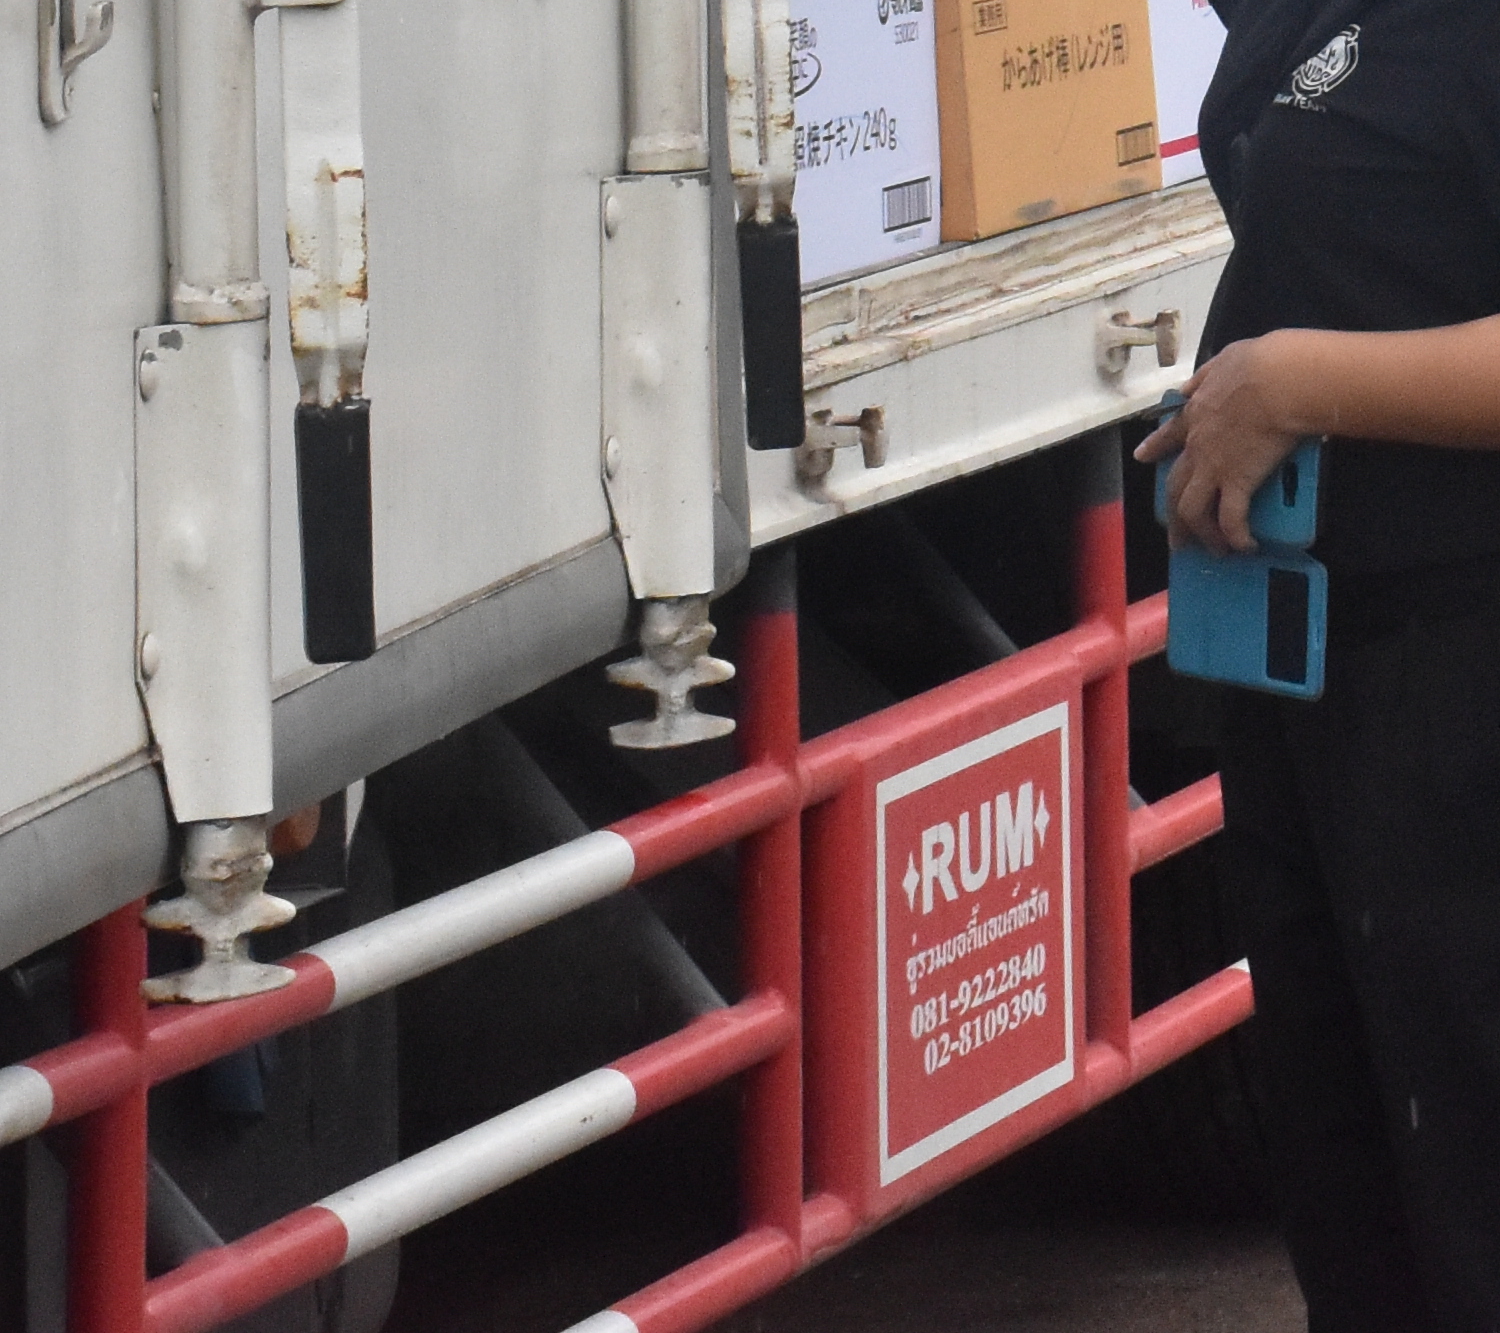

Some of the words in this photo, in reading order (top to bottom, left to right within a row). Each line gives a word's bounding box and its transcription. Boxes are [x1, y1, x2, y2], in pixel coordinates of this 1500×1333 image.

[921, 780, 1034, 916] RUM
[911, 942, 1047, 1040] 081-9222840
[924, 983, 1047, 1076] 02-8109396
